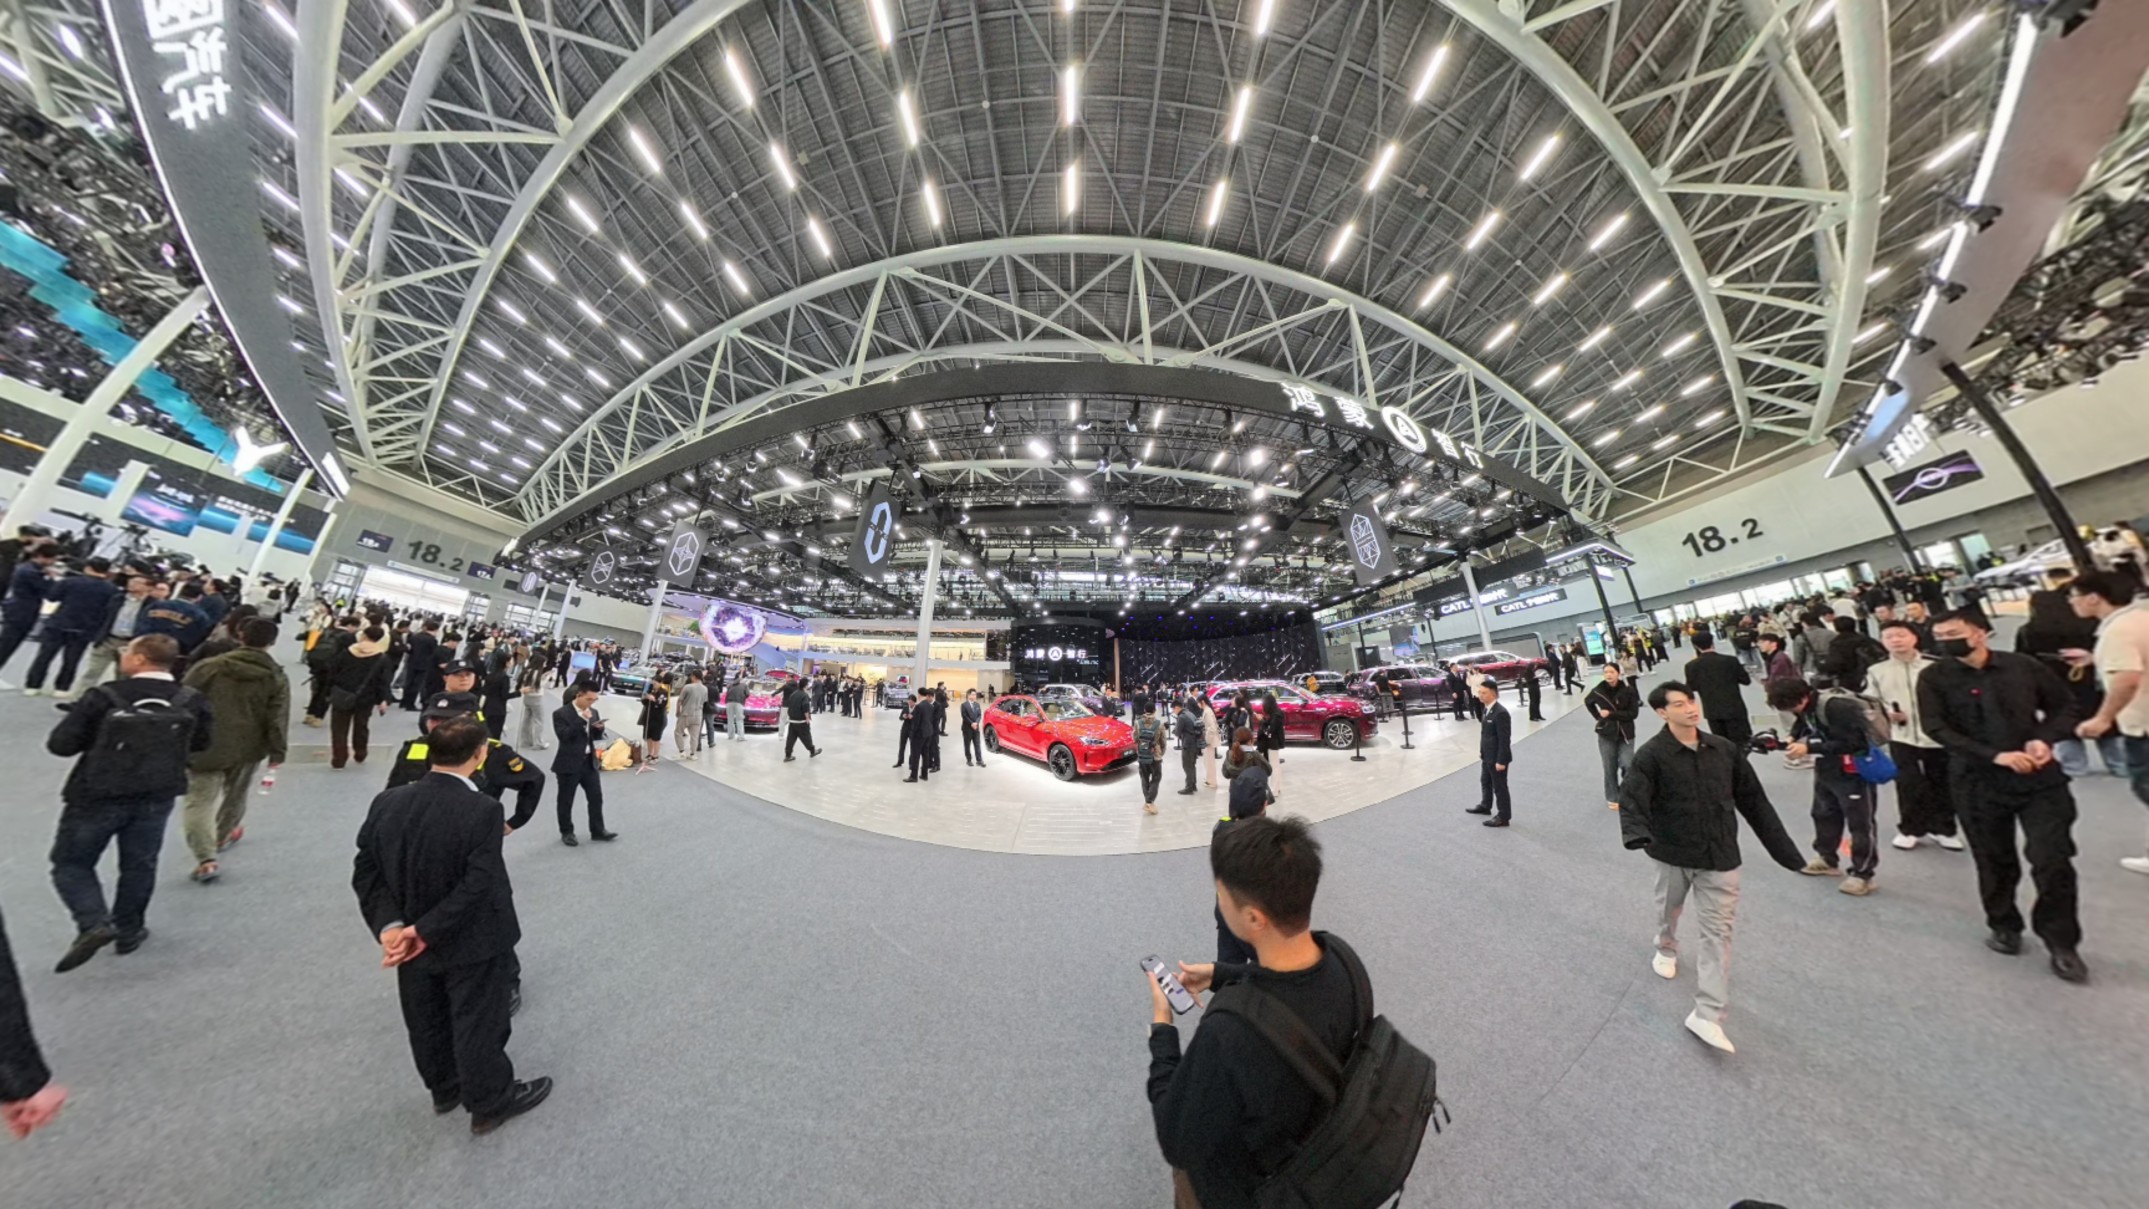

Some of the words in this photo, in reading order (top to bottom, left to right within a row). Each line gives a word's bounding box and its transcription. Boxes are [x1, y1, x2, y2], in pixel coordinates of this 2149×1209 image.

[1281, 382, 1375, 430] 鸿蒙
[1431, 427, 1484, 469] 智行
[1682, 518, 1764, 557] 18.2
[408, 540, 464, 572] 18.2
[1440, 600, 1471, 614] CATL
[1500, 600, 1528, 613] CATL
